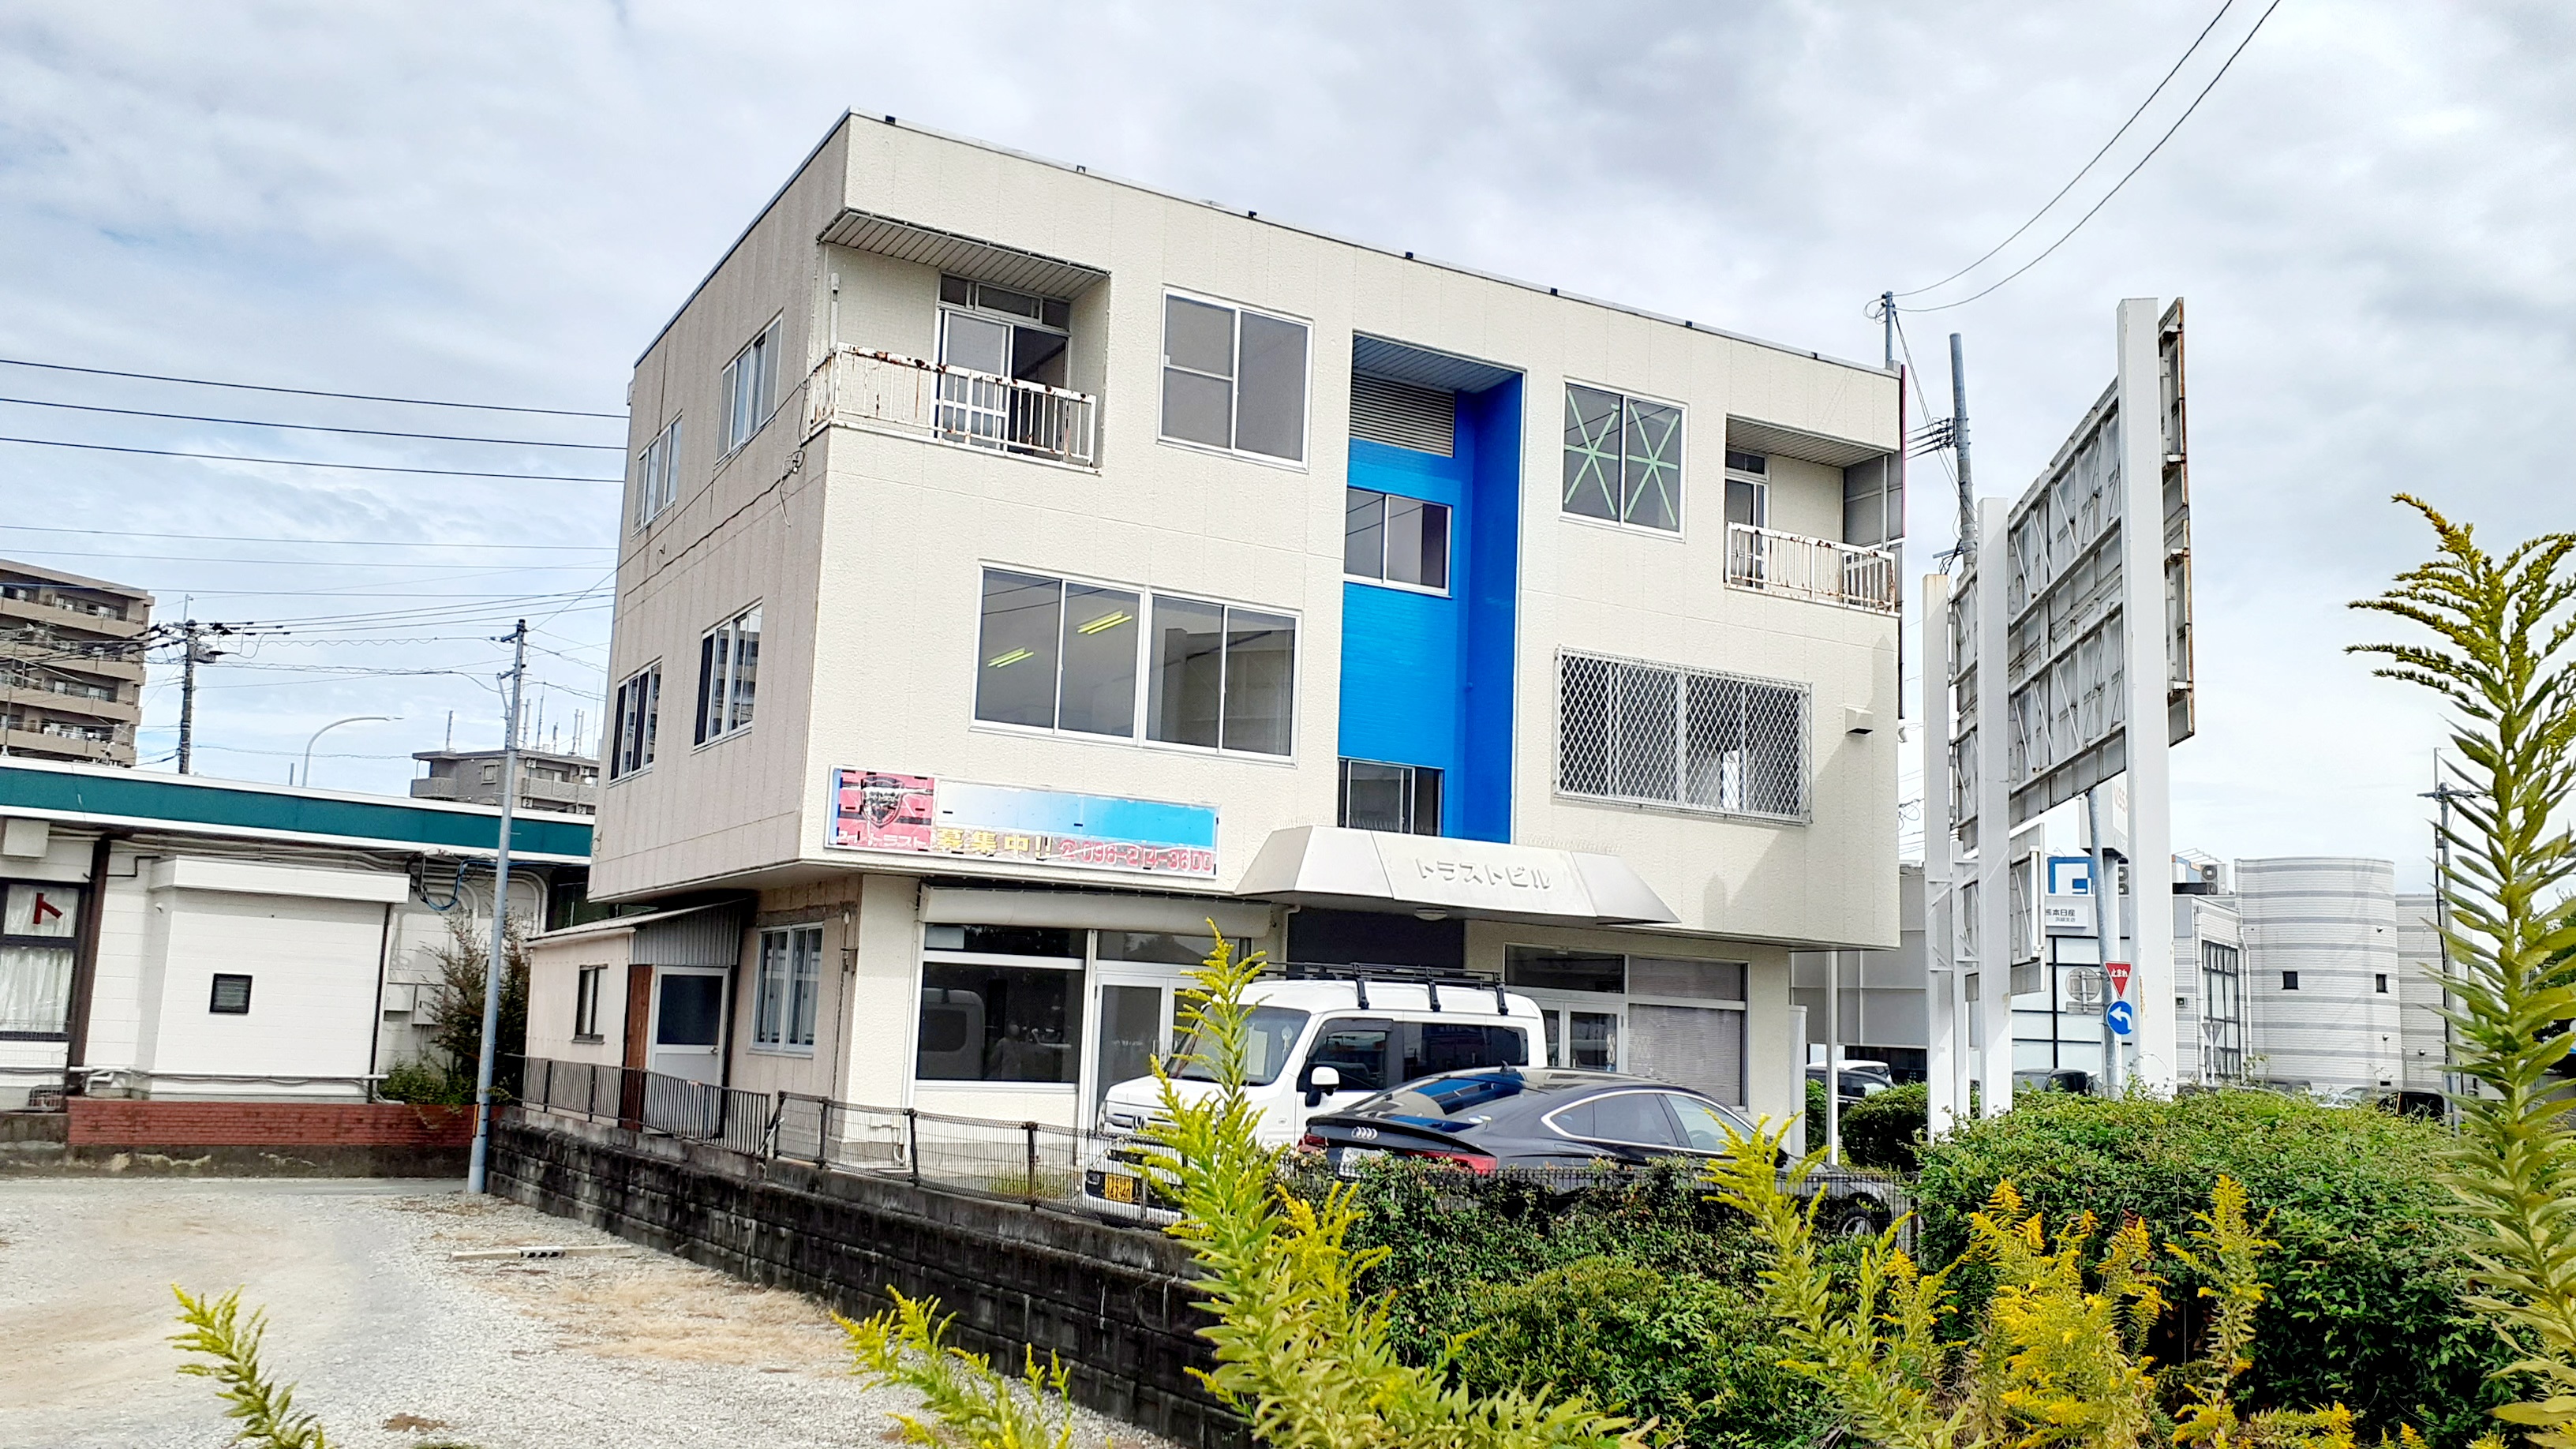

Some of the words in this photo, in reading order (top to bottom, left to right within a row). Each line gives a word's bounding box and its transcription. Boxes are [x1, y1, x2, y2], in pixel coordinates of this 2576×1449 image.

[1415, 857, 1551, 889] トラストビル
[32, 892, 63, 925] ト
[2110, 968, 2129, 978] 止まれ
